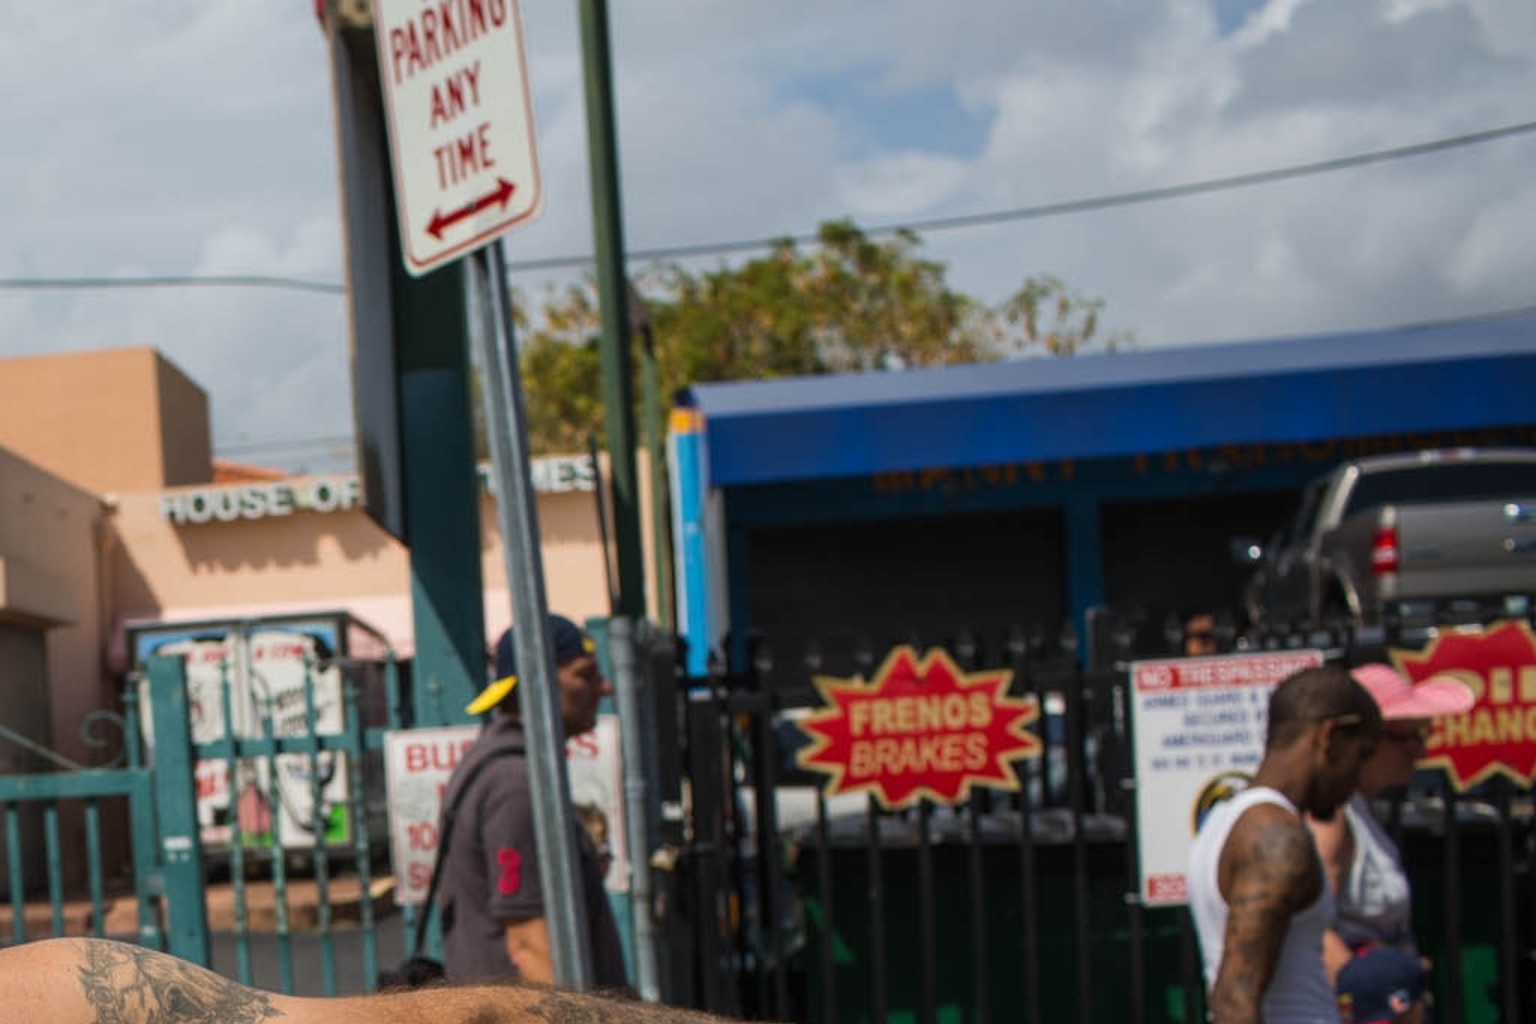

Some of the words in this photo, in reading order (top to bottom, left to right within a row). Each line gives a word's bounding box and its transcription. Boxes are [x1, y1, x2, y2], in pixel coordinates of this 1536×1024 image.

[429, 60, 481, 130] ANY
[433, 121, 495, 191] TIME
[158, 482, 292, 525] HOUSE
[310, 476, 360, 513] OF
[849, 692, 991, 736] FRENOS
[849, 732, 988, 777] BRAKES
